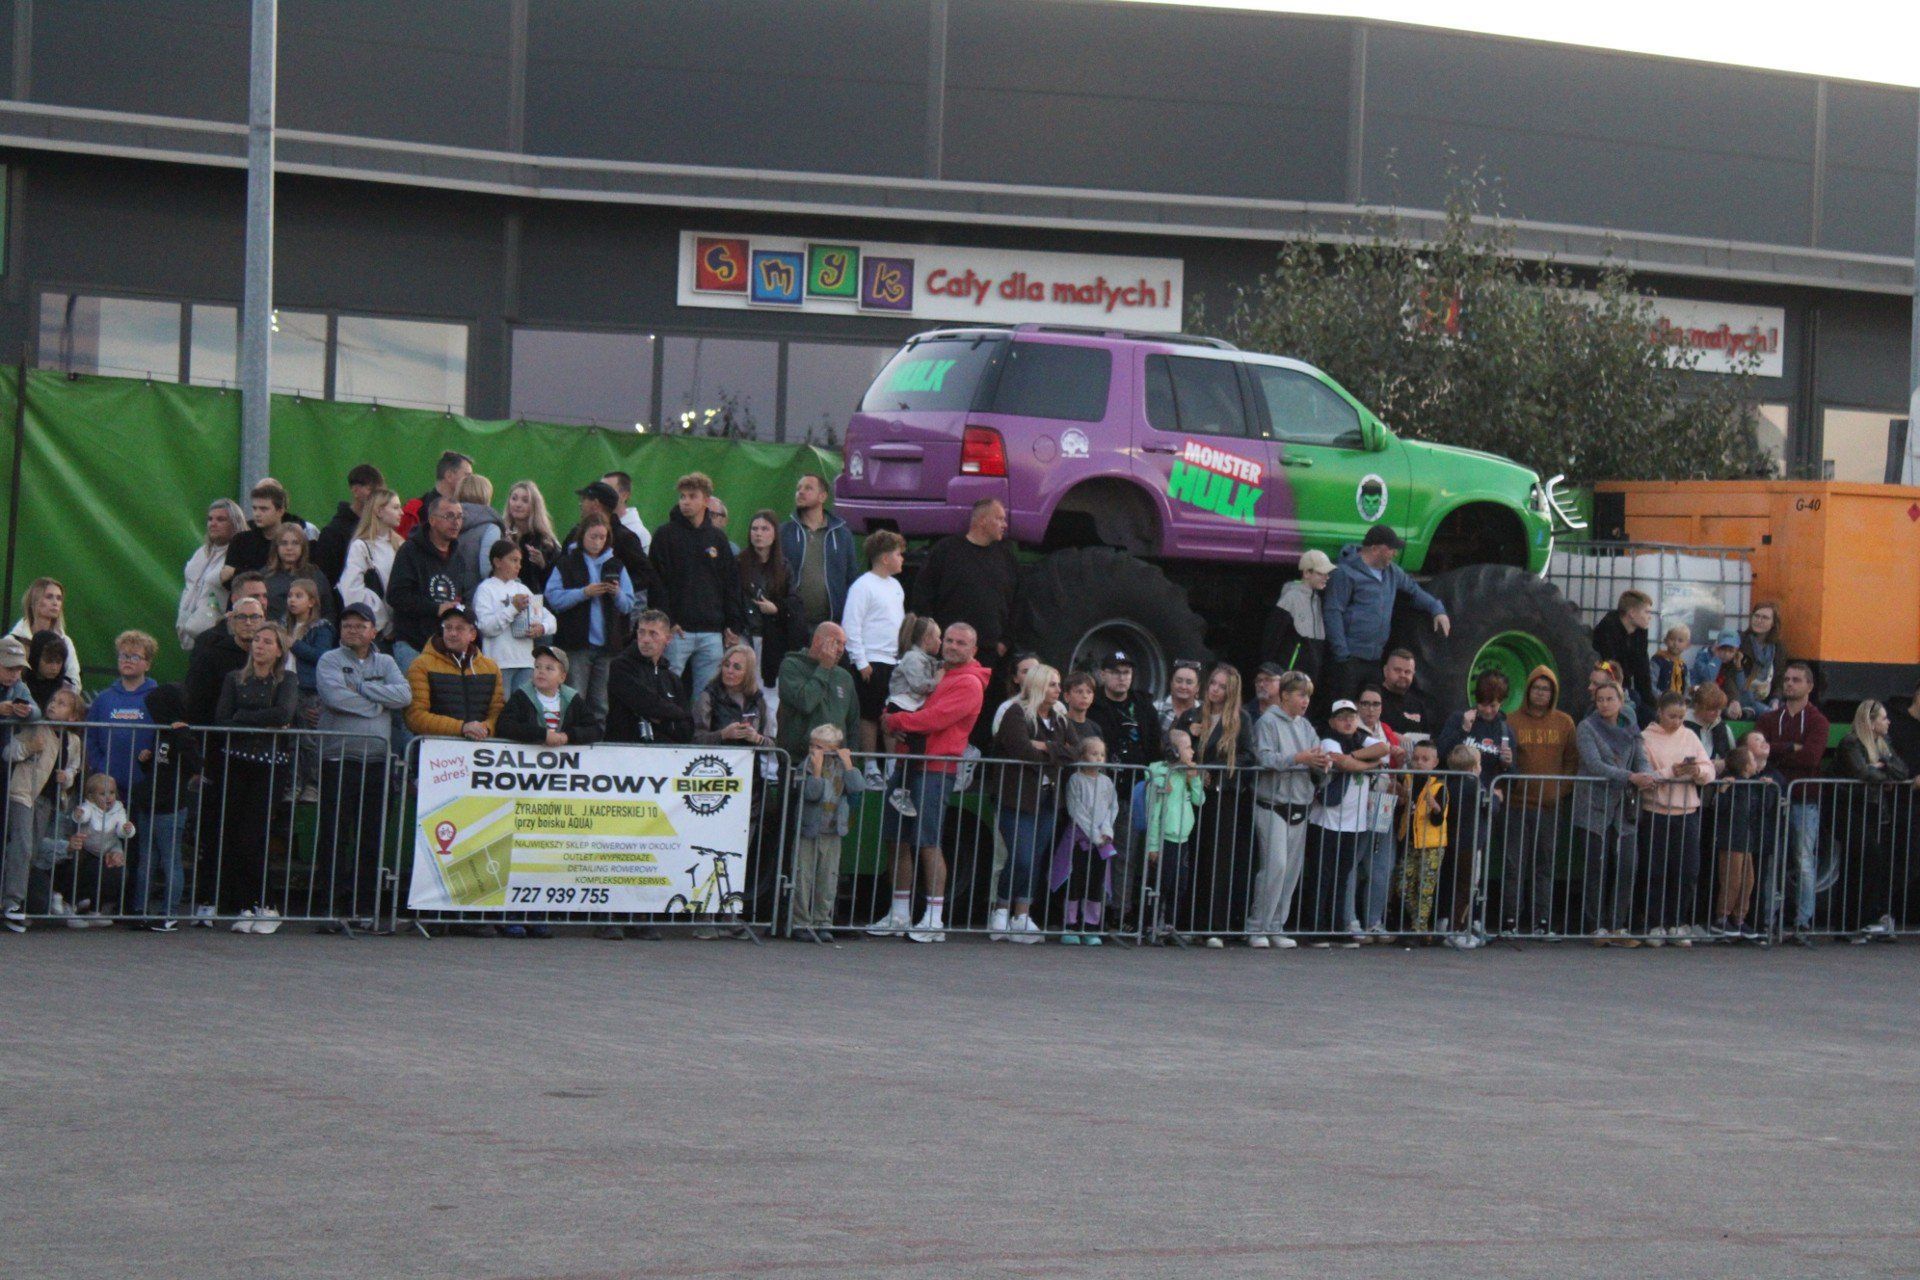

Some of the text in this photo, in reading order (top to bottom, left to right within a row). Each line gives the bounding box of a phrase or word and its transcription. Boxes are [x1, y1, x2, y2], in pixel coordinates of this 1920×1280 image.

[926, 268, 992, 306] Cały
[999, 271, 1045, 301] dla
[1184, 441, 1262, 485] MONSTER
[1167, 459, 1265, 527] HULK
[1795, 499, 1821, 512] G-40
[429, 755, 465, 771] Nowy
[473, 749, 580, 770] SALON
[433, 766, 470, 784] adres!
[471, 771, 669, 795] ROWEROWY
[676, 779, 740, 793] BIKER
[648, 806, 658, 818] 10
[515, 817, 593, 831] (przy boisku AQUA)
[566, 841, 590, 850] SKLEP
[591, 841, 637, 851] ROWEROWY
[640, 842, 648, 851] W
[649, 842, 682, 852] OKOLICY
[562, 853, 593, 861] OUTLET
[567, 864, 658, 873] DETAILING ROWEROWY
[575, 876, 667, 885] KOMPLEKSOWY SERWIS
[511, 887, 610, 904] 727 939 755
